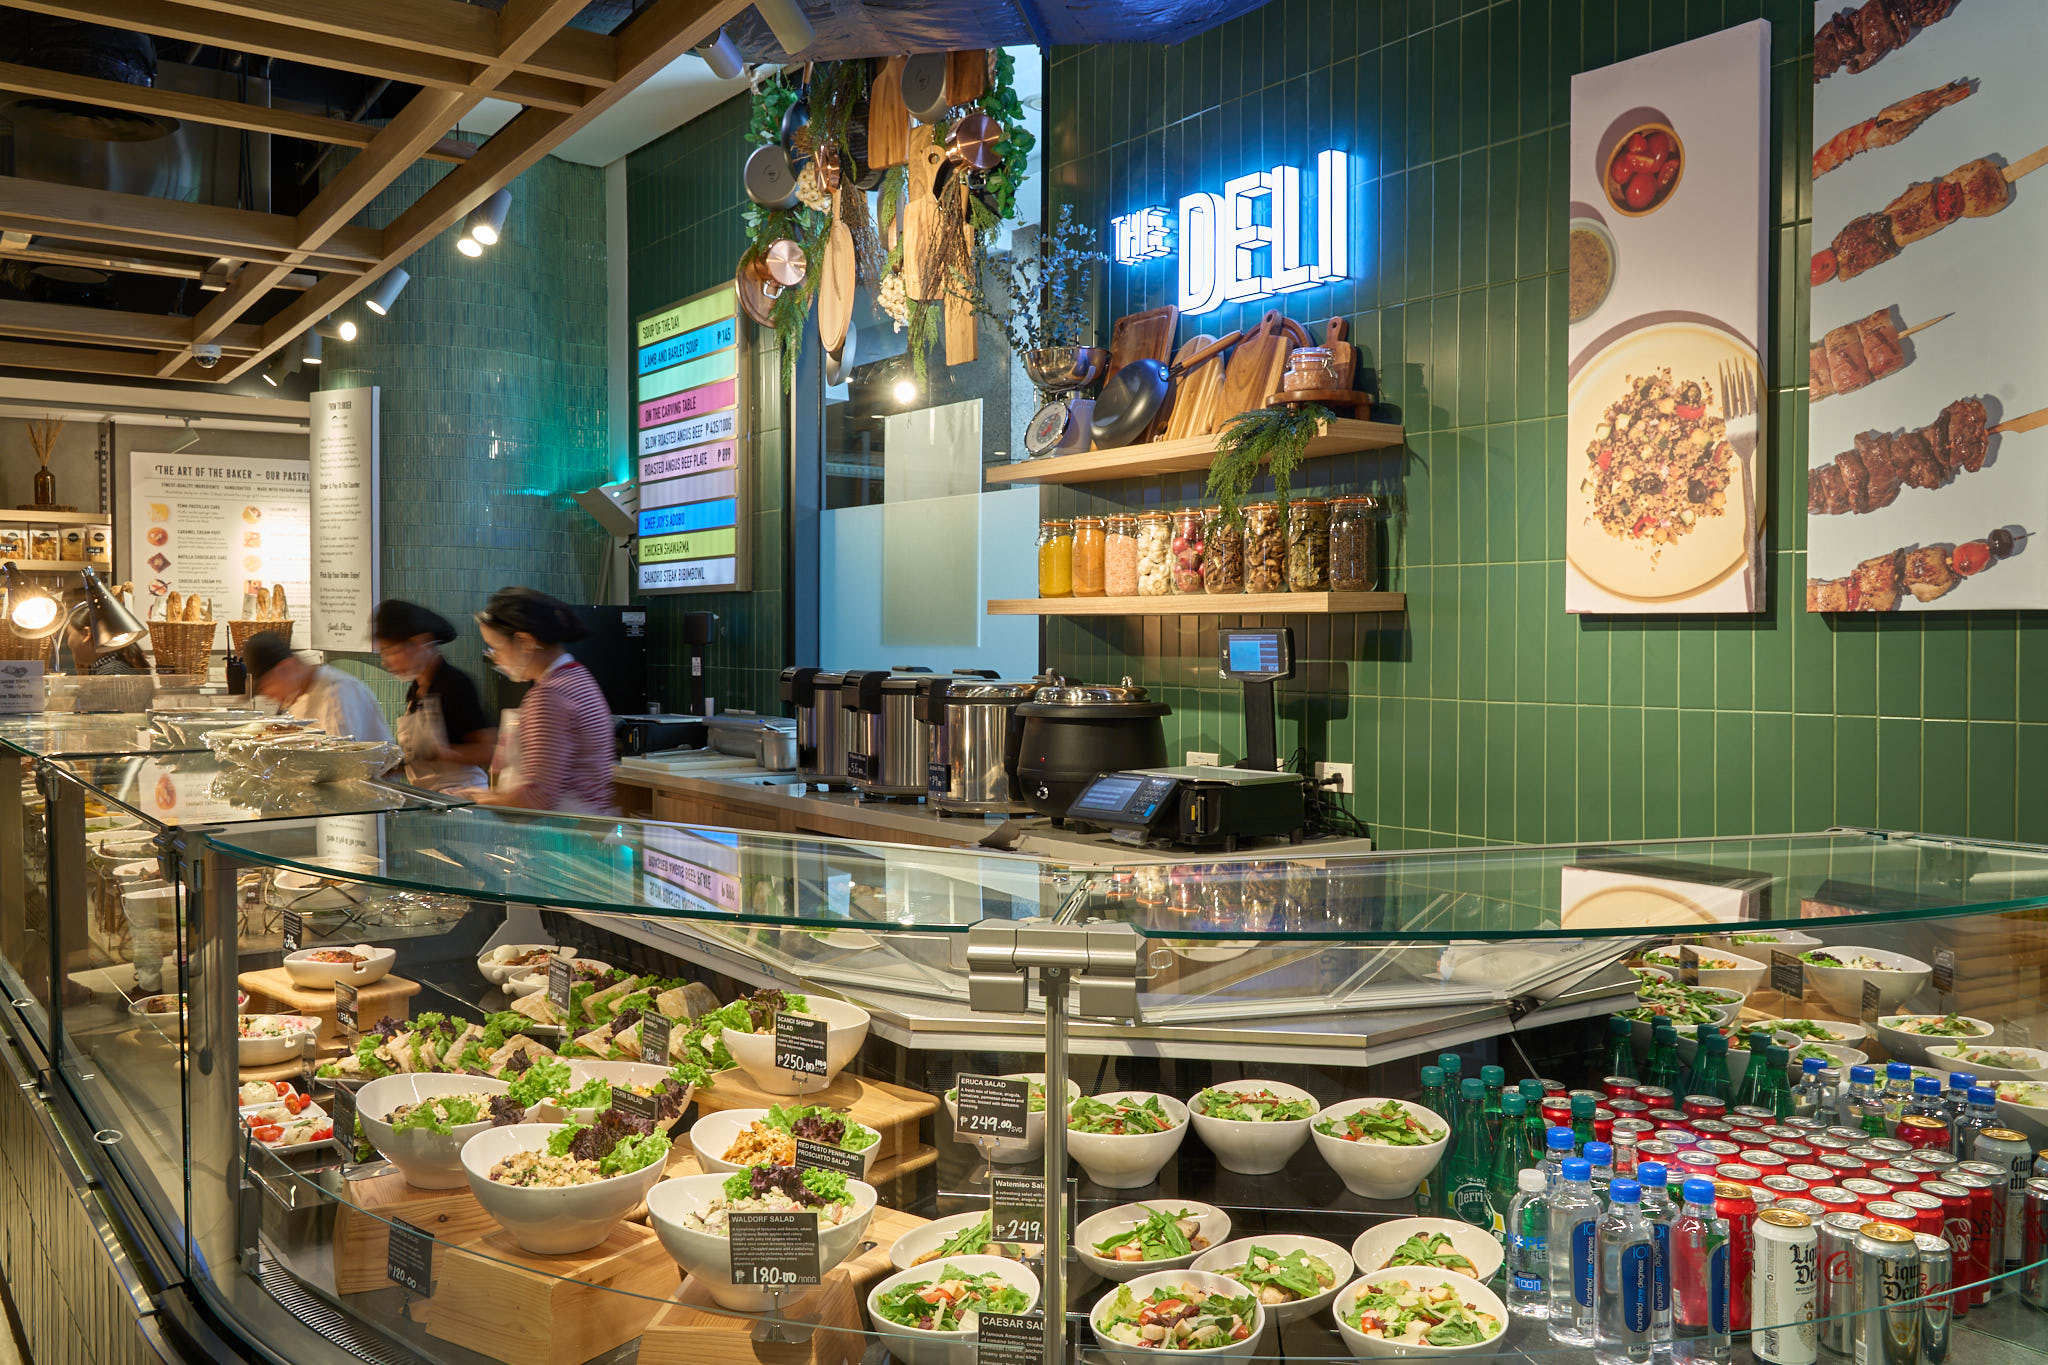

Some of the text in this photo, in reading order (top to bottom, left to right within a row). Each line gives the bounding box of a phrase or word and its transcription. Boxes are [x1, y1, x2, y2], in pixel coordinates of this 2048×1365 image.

[1110, 149, 1349, 316] THE DELI
[643, 315, 679, 339] SOUP OF THE DAY
[644, 353, 656, 368] LAMB
[659, 349, 667, 363] AND
[668, 344, 685, 360] BARLEY
[686, 339, 698, 355] SOUP
[722, 328, 731, 343] 145
[645, 396, 696, 422] ON THE CARVING TABLE
[645, 437, 656, 449] SLOW
[658, 431, 676, 446] ROASTED
[677, 427, 691, 441] ANGUS
[693, 425, 703, 439] BEEF
[645, 462, 664, 476] ROASTED
[665, 458, 680, 472] ANGUS
[682, 455, 692, 470] BEEF
[694, 452, 707, 467] PLATE
[155, 465, 174, 475] THE
[177, 467, 192, 476] ART
[196, 467, 205, 476] OF
[208, 468, 224, 478] THE
[227, 469, 252, 479] BAKER
[266, 471, 280, 480] OUR
[645, 540, 689, 557] CHICKEN SHAWARMA
[664, 569, 677, 582] STEAK
[778, 1016, 814, 1027] SCANDI SHRIMP
[961, 1078, 1006, 1088] ERUCA SALAD
[613, 1089, 642, 1104] CORN SALAD
[810, 1145, 827, 1153] PESTO
[828, 1149, 845, 1158] PENNE
[846, 1153, 858, 1161] AND
[832, 1158, 849, 1166] SALAD
[995, 1180, 1030, 1188] Watemiso
[1458, 1190, 1484, 1206] Perri
[1008, 1220, 1044, 1240] 249.
[1584, 1223, 1596, 1236] 10
[1790, 1244, 1817, 1266] Liq
[1877, 1258, 1919, 1285] Liqu
[1883, 1281, 1919, 1300] Dea
[982, 1316, 1023, 1328] CAESAR
